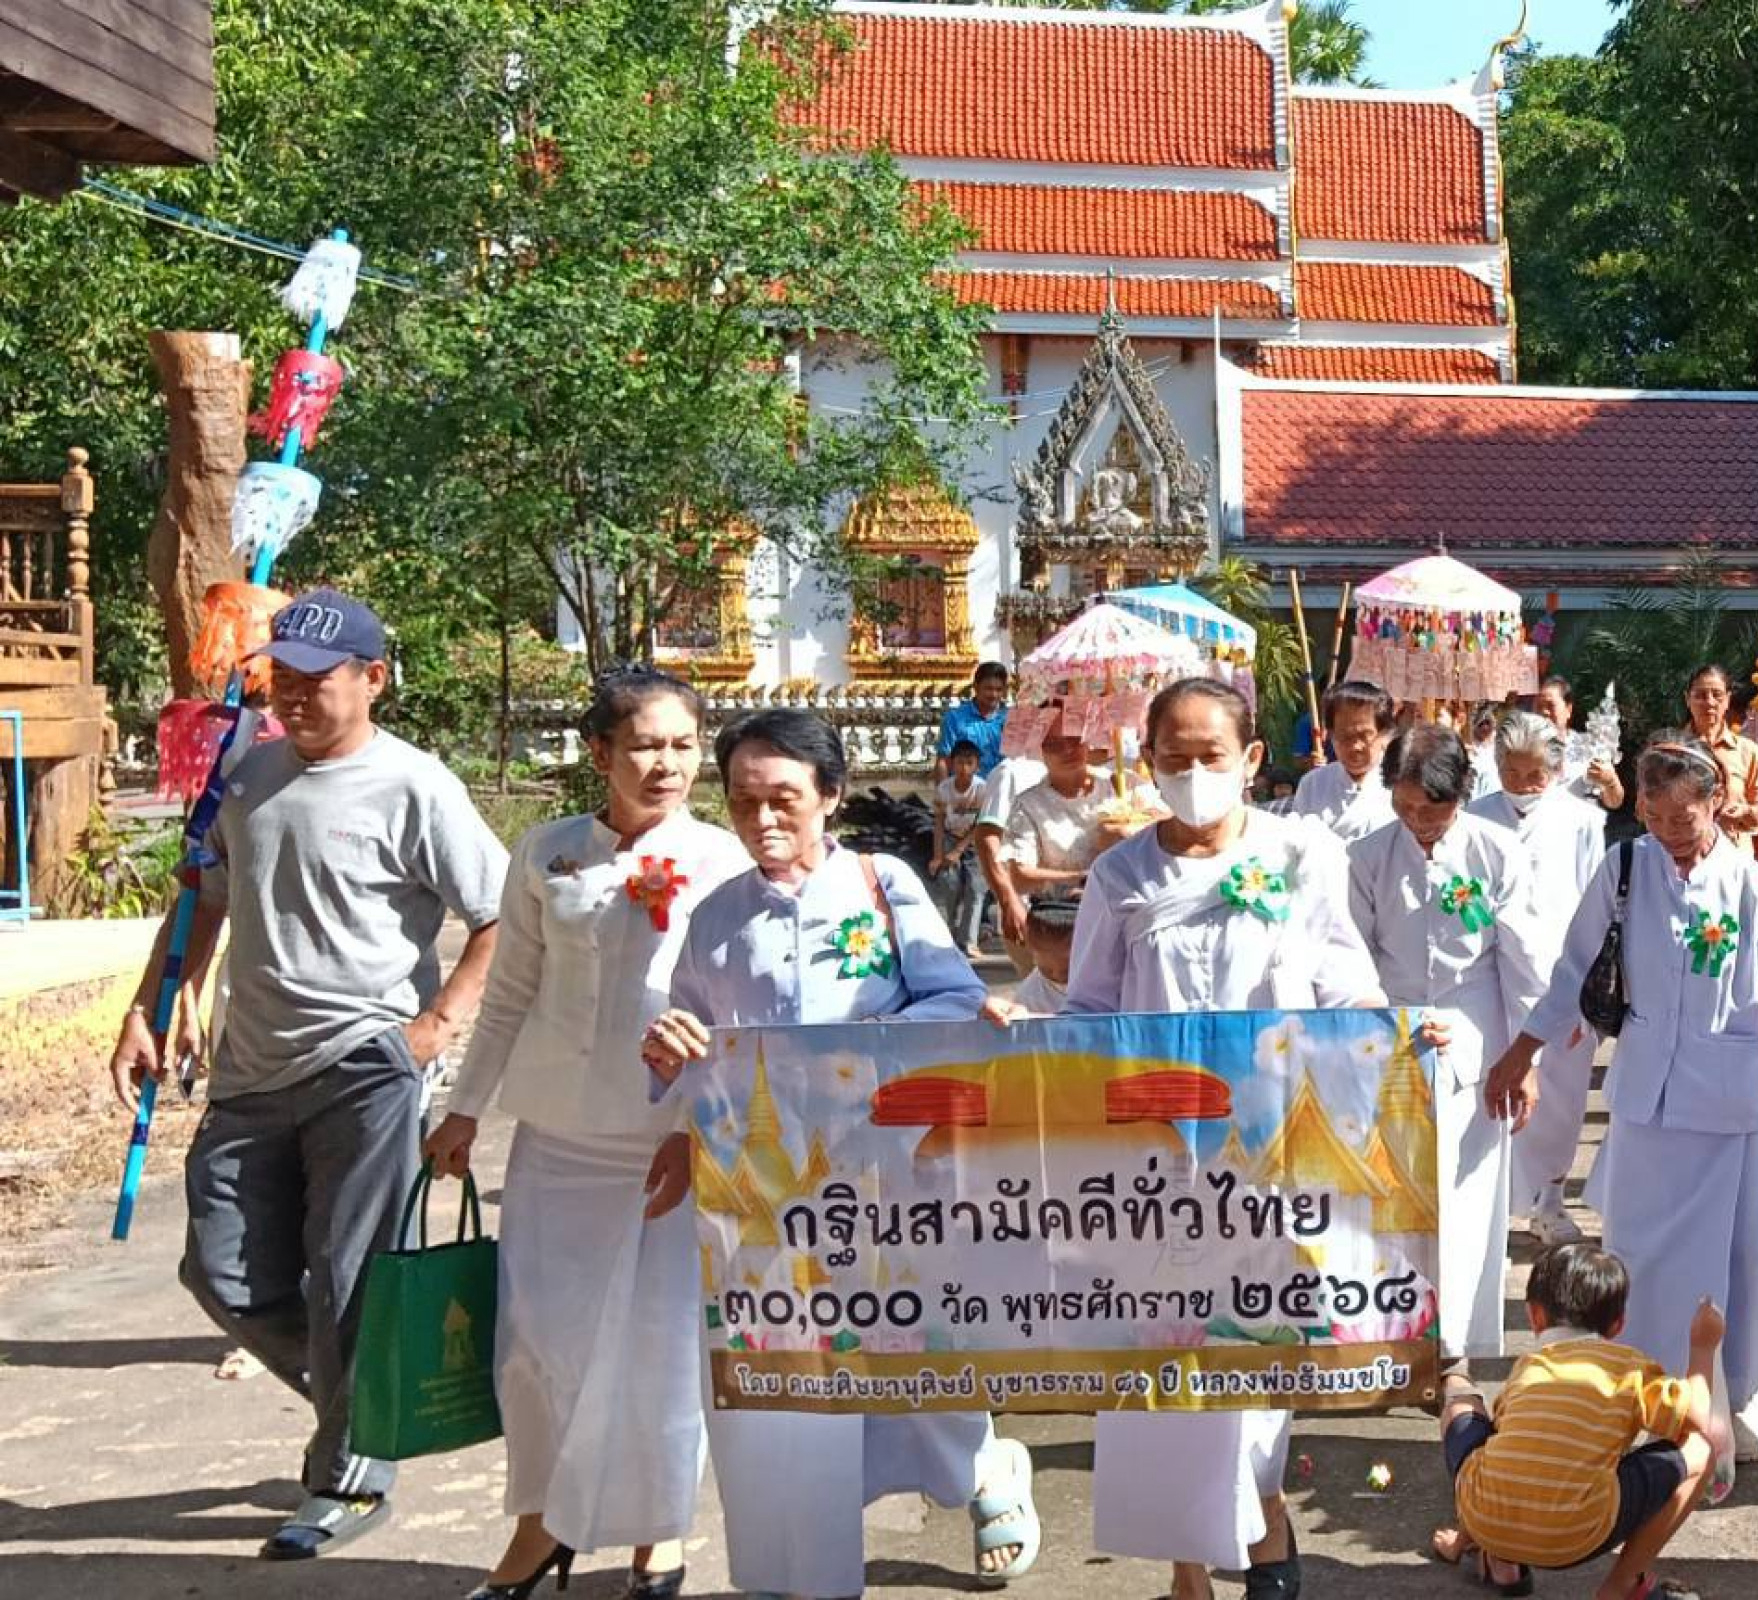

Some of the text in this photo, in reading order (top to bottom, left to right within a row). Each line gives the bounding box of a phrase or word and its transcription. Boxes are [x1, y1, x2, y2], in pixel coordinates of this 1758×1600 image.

[782, 1156, 1333, 1268] กฐินสามัคคีทั่วไทย
[724, 1269, 1418, 1338] ๓๐,๐๐๐ วัด พุทธศักราช ๒๕๖๘
[737, 1365, 780, 1395] โดย
[788, 1364, 976, 1409] คณะศิษยานุศิษย์
[1159, 1360, 1182, 1393] ปี
